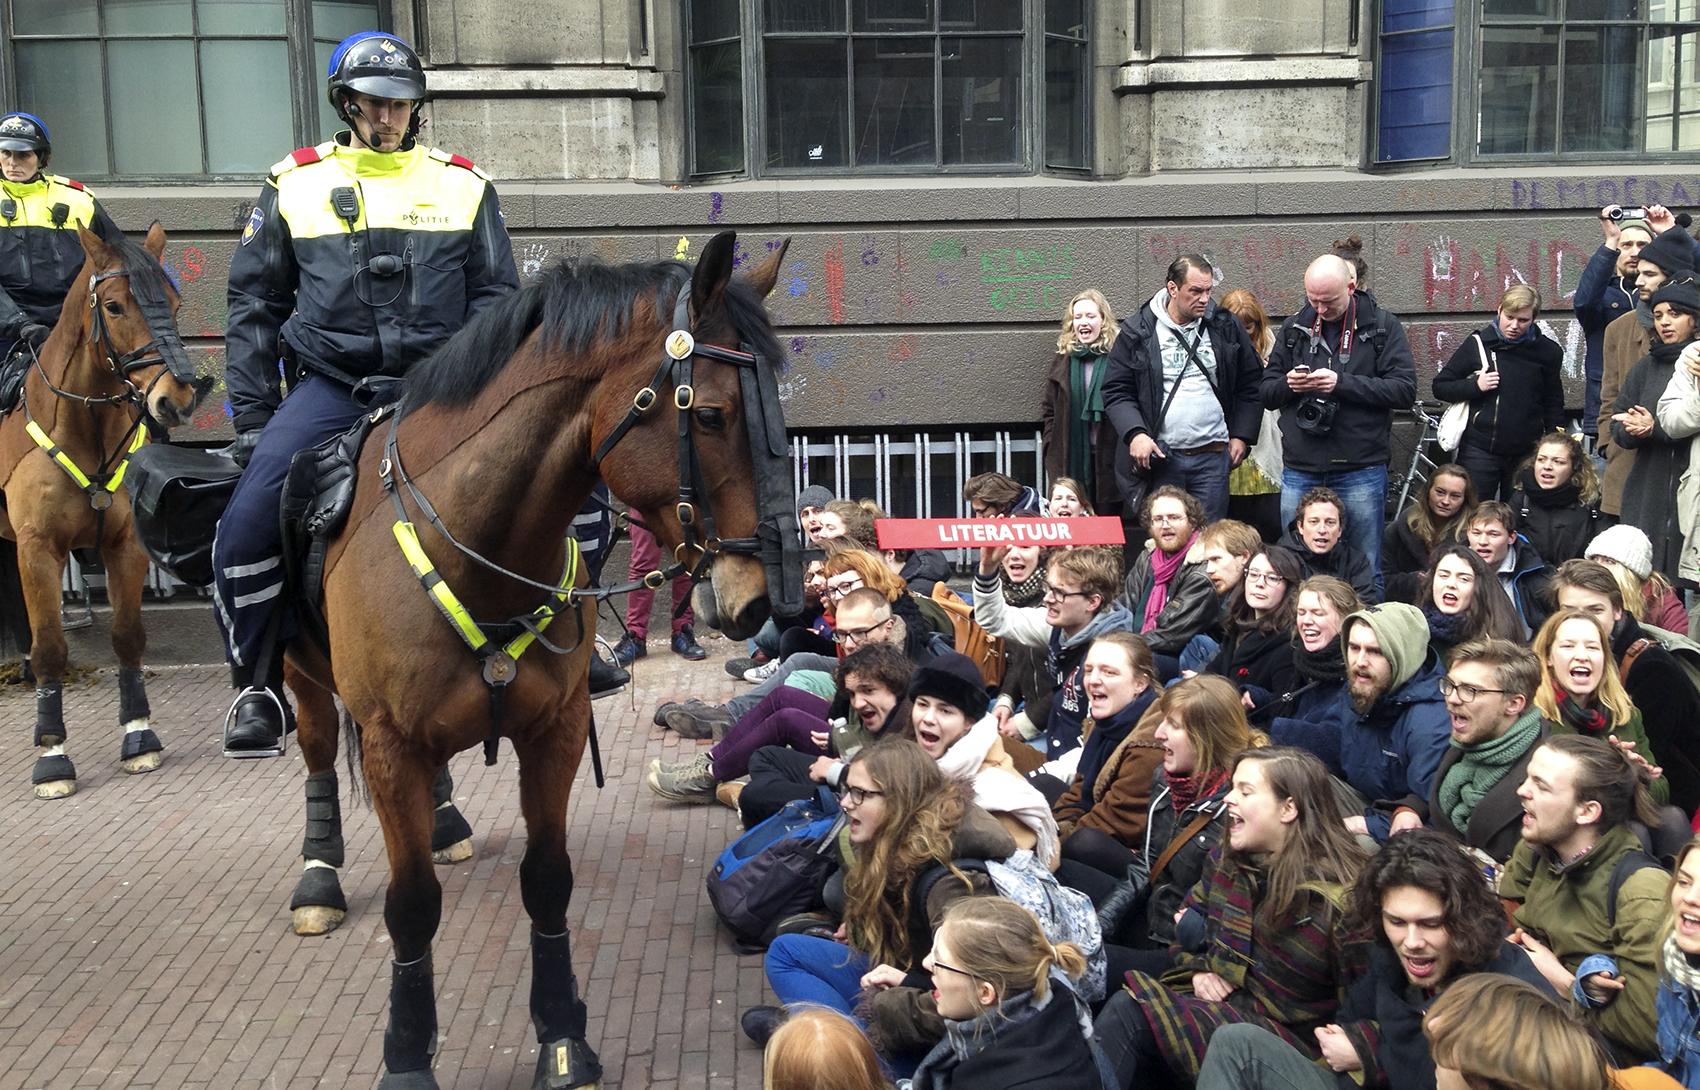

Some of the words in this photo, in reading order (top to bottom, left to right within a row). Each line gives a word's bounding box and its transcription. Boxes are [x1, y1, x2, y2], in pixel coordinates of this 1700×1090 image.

[1511, 176, 1700, 209] DEMOCRA
[402, 209, 449, 225] POLITIE
[938, 523, 1072, 542] LITERATUUR
